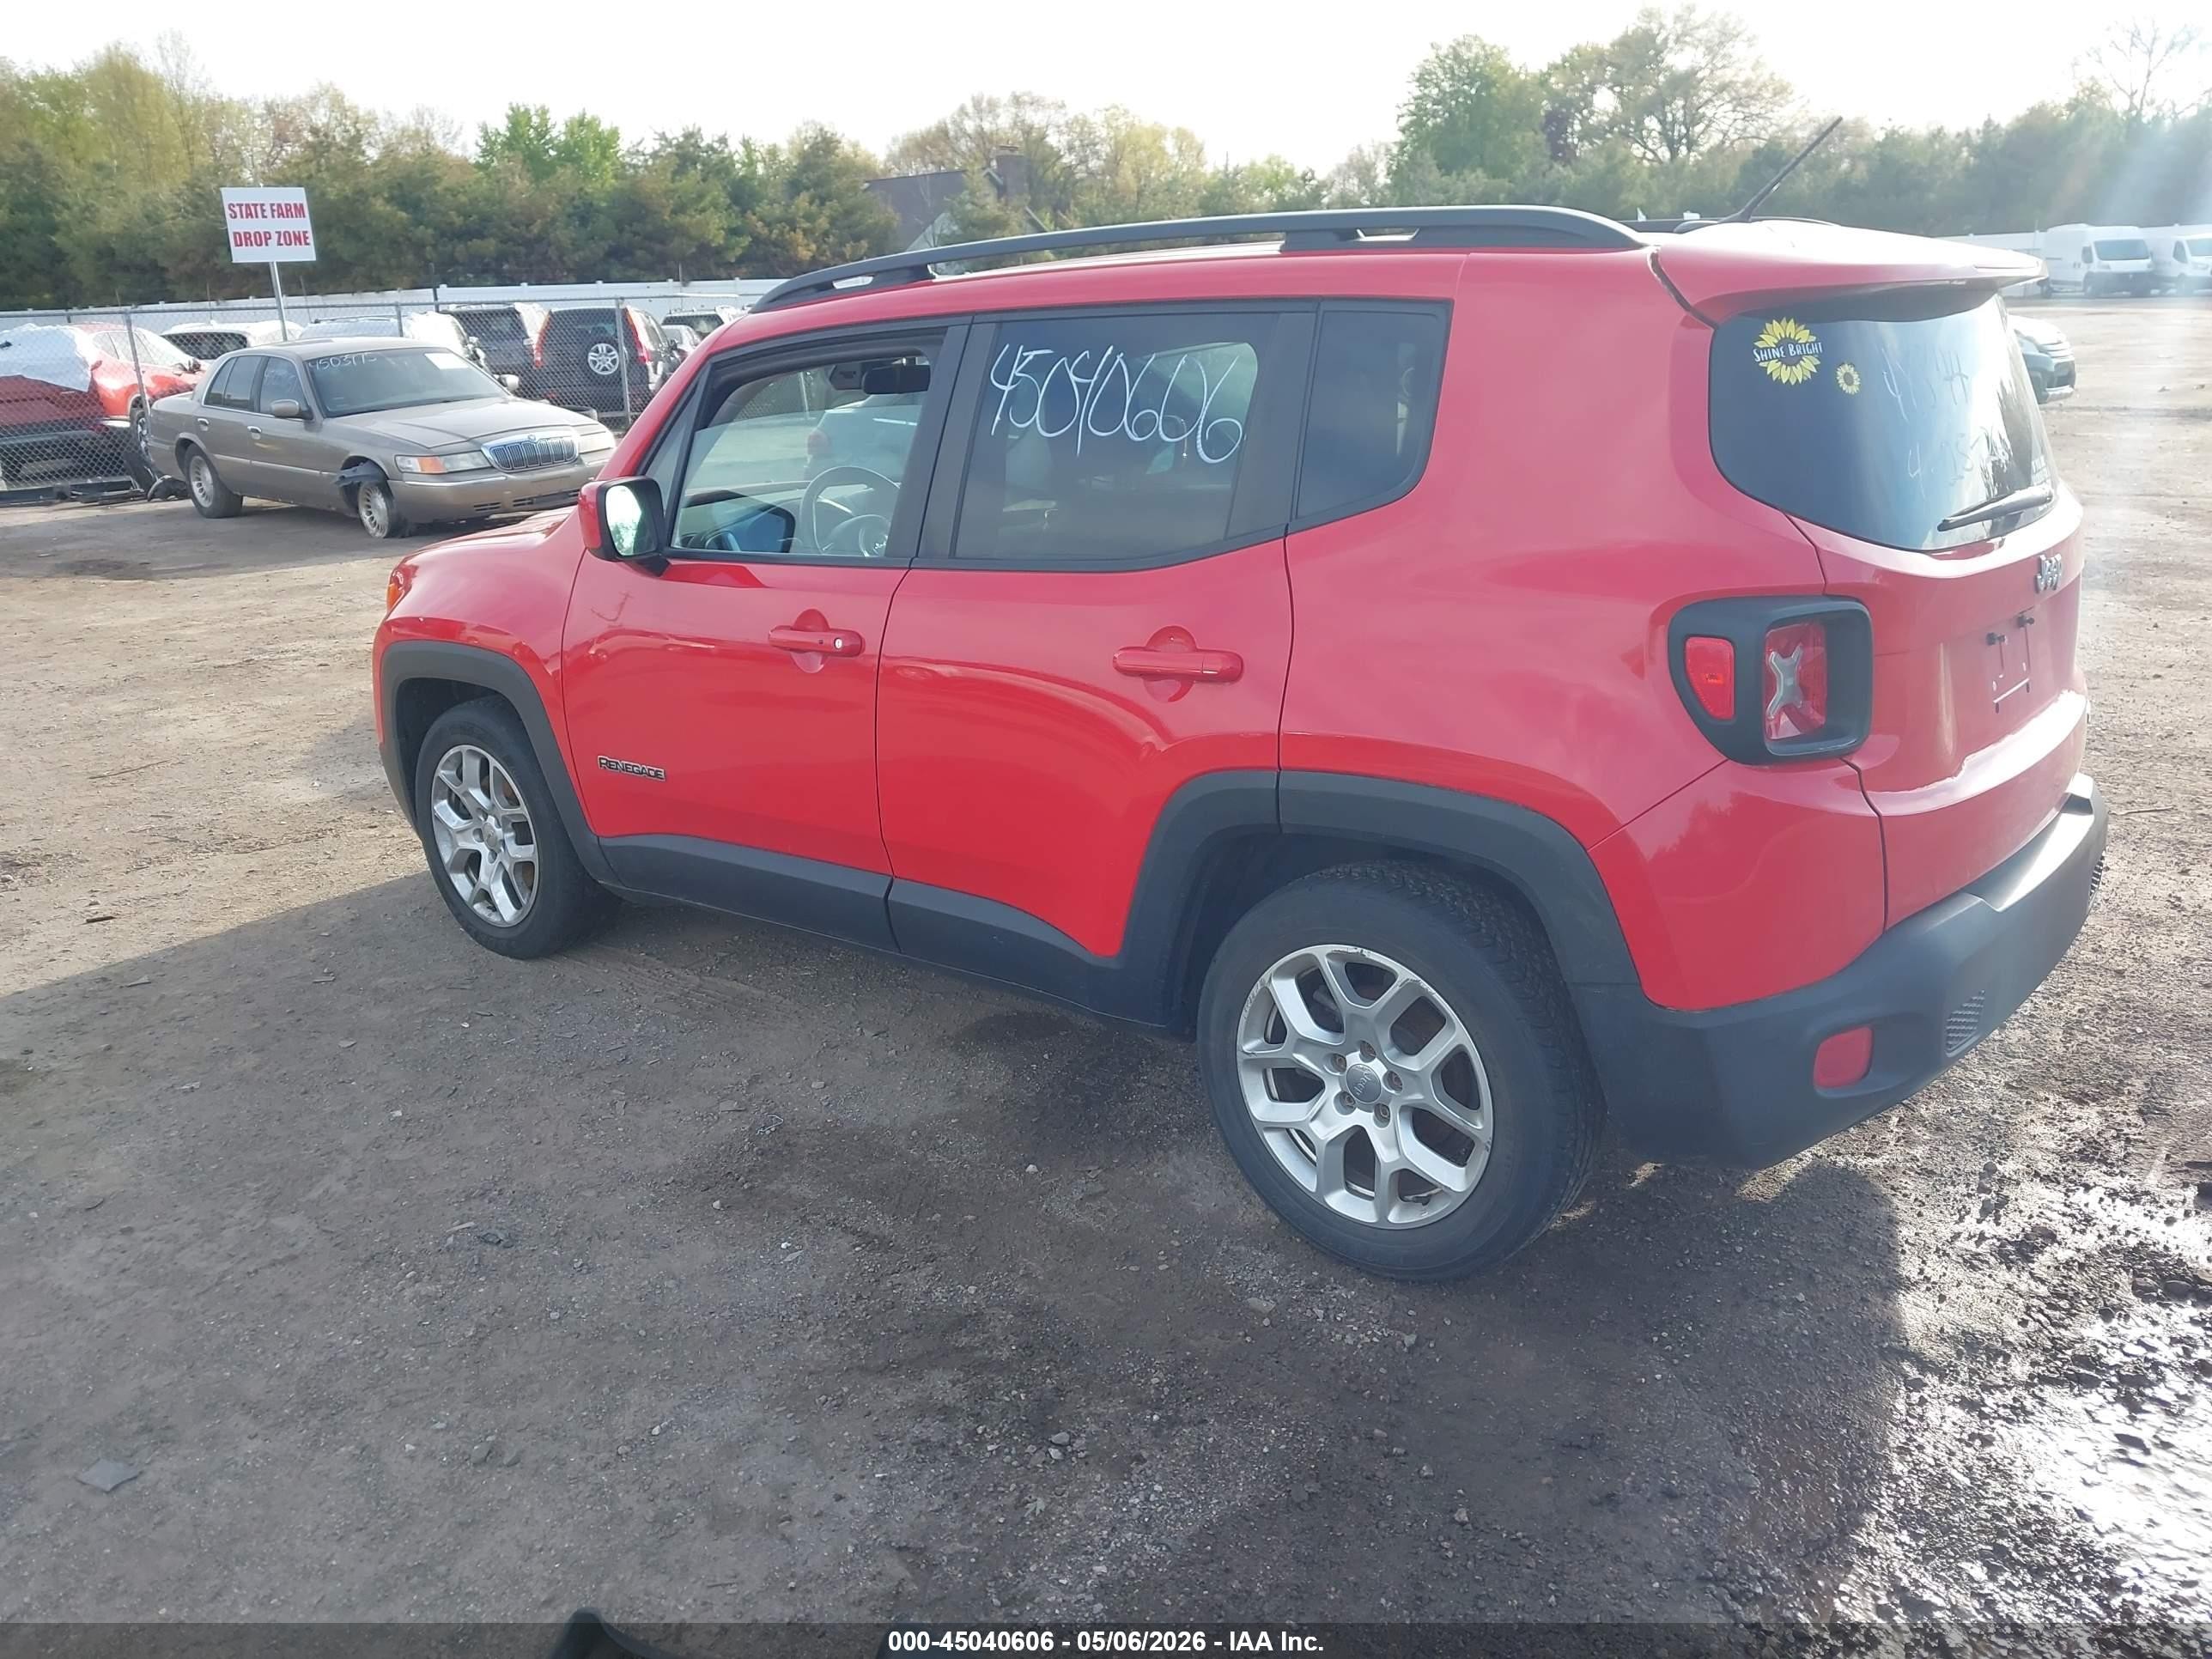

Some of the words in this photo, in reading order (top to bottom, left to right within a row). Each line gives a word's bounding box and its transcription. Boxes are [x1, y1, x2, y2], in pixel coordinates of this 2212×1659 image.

[228, 203, 267, 219] STATE
[270, 203, 306, 219] FARM
[233, 231, 271, 247] DROP
[275, 230, 310, 246] ZONE
[990, 343, 1243, 464] 45040606
[598, 756, 665, 781] RENEGADE
